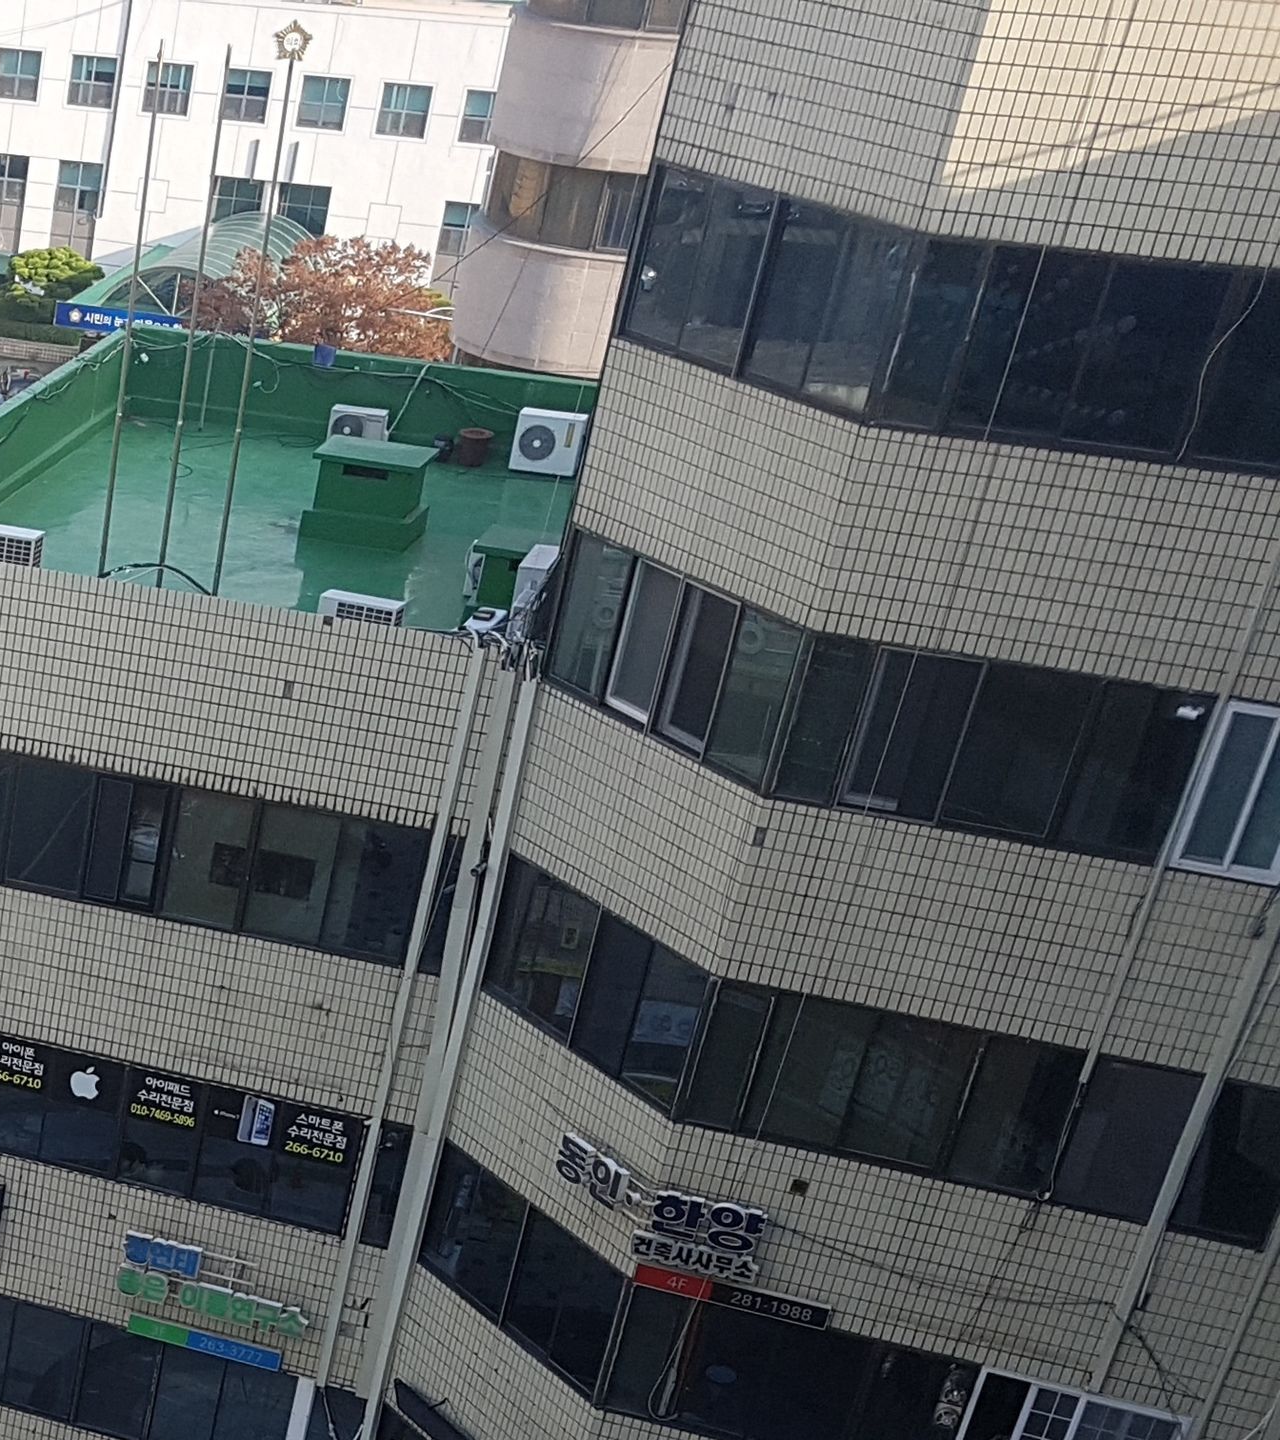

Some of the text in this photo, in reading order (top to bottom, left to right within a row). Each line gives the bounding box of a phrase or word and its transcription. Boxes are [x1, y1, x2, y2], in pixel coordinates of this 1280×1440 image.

[1, 1040, 36, 1060] 아이폰
[144, 1075, 192, 1097] 아이패드
[135, 1086, 196, 1114] 수리전문점
[294, 1112, 345, 1133] 스마트폰
[286, 1124, 348, 1151] 수리전문점
[284, 1139, 344, 1164] 266-6710
[630, 1234, 760, 1284] 건축사사무소
[666, 1275, 688, 1290] 4F
[729, 1291, 812, 1323] 281-1988
